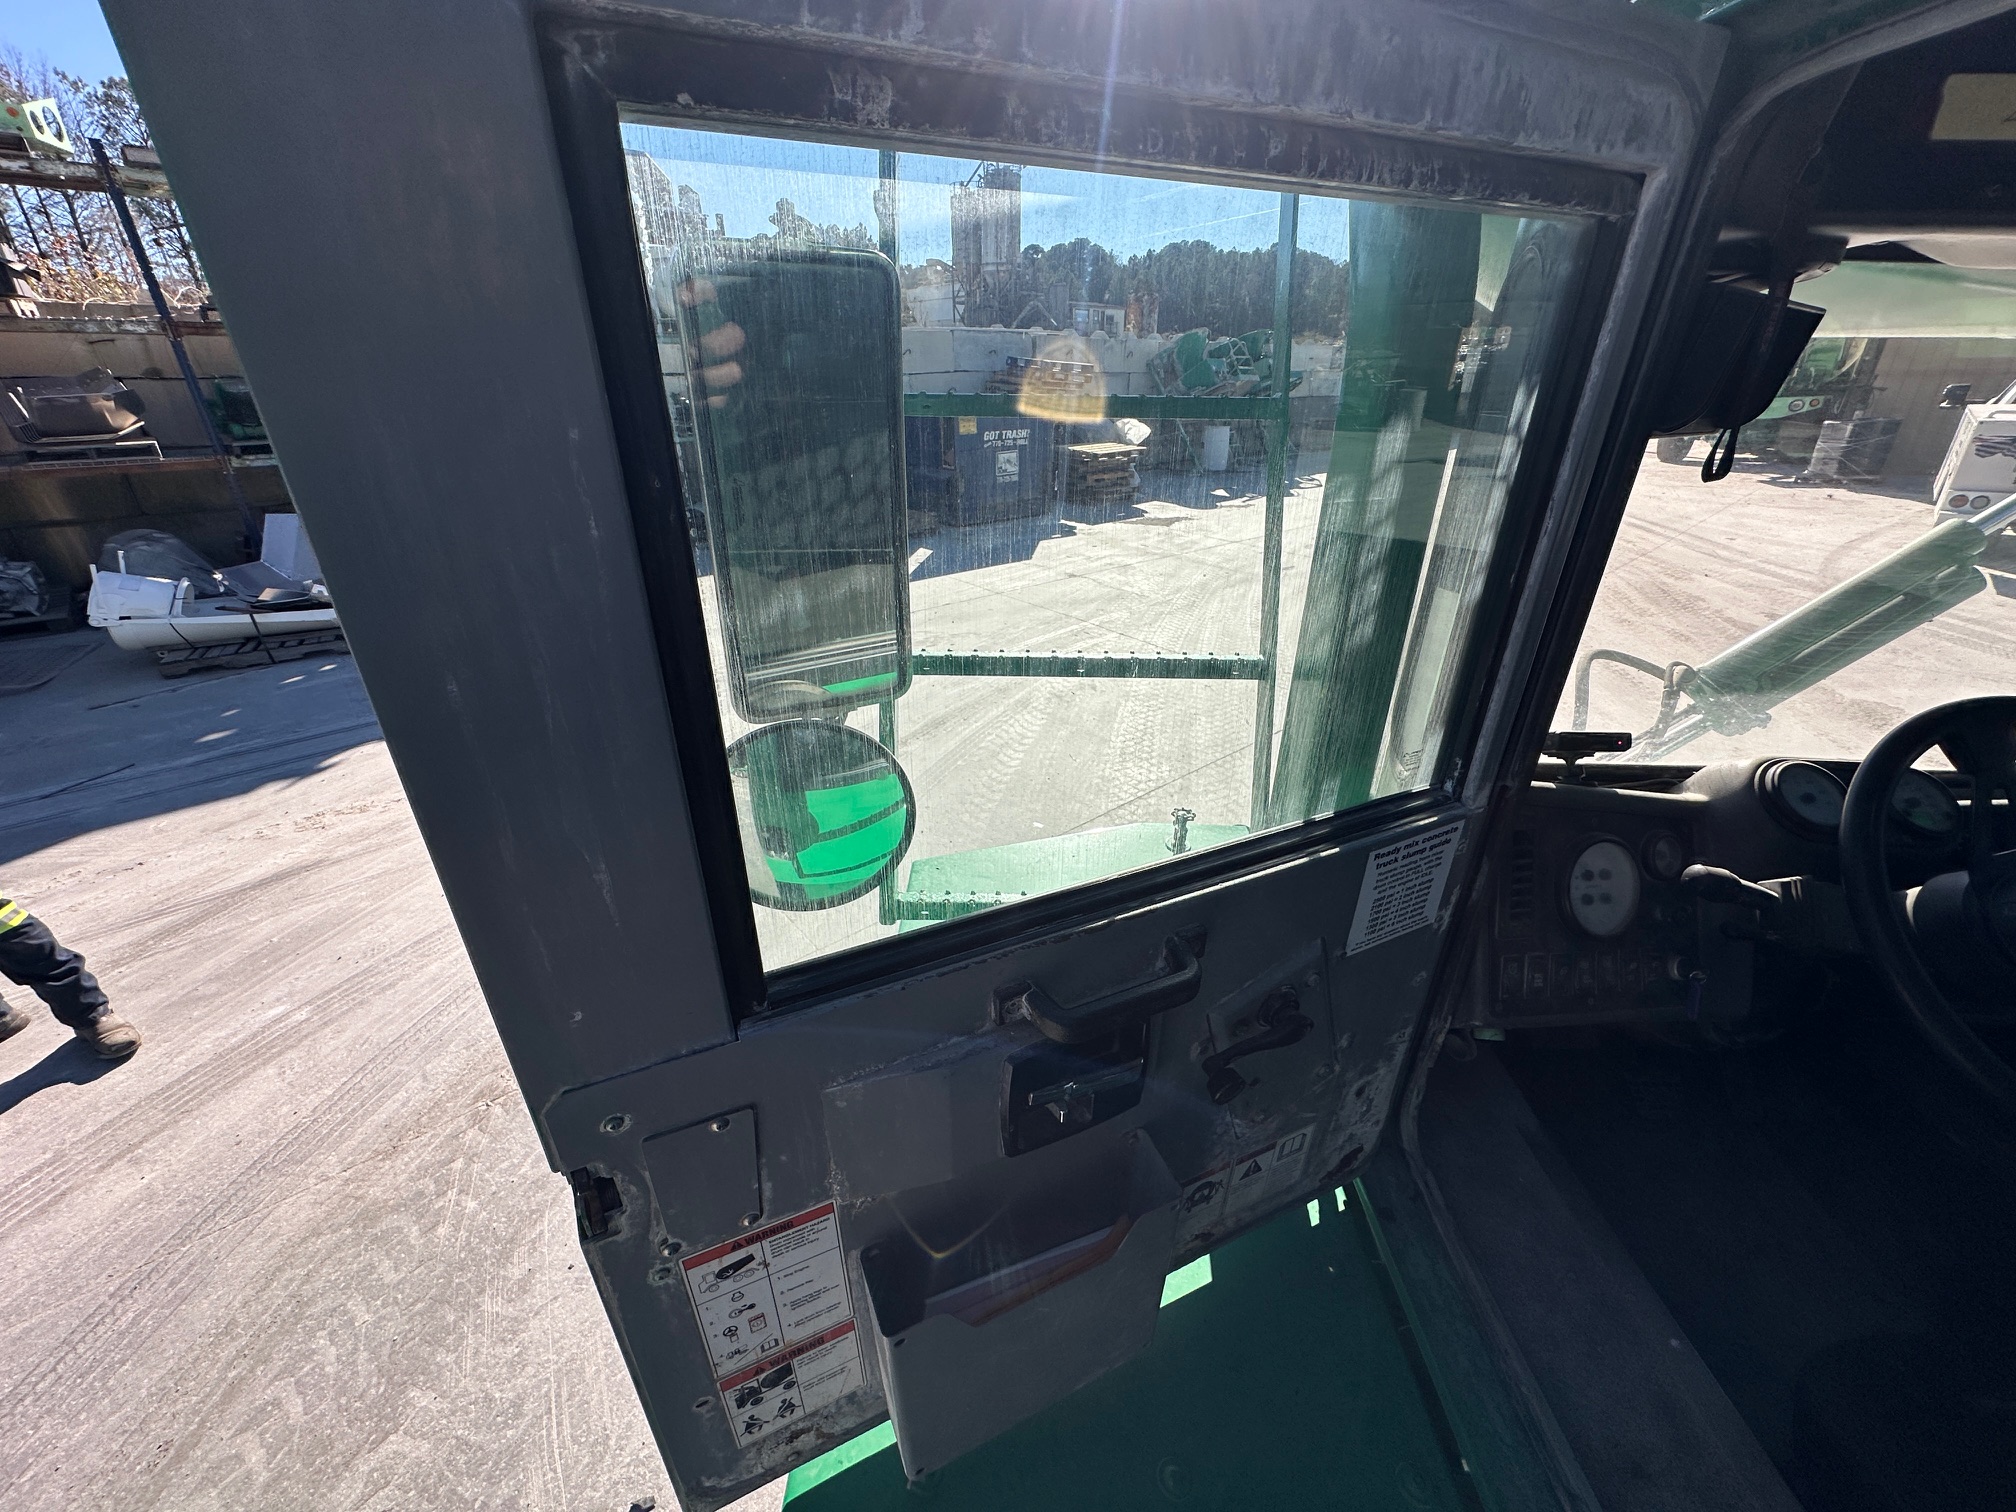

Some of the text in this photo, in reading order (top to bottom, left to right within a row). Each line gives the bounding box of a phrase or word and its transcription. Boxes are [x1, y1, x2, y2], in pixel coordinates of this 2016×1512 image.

[984, 431, 1000, 441] GOT
[1374, 826, 1459, 861] Ready mix concrete
[1376, 838, 1451, 870] truck slump guide
[745, 1221, 794, 1245] WARNING
[768, 1337, 825, 1367] WARNING
